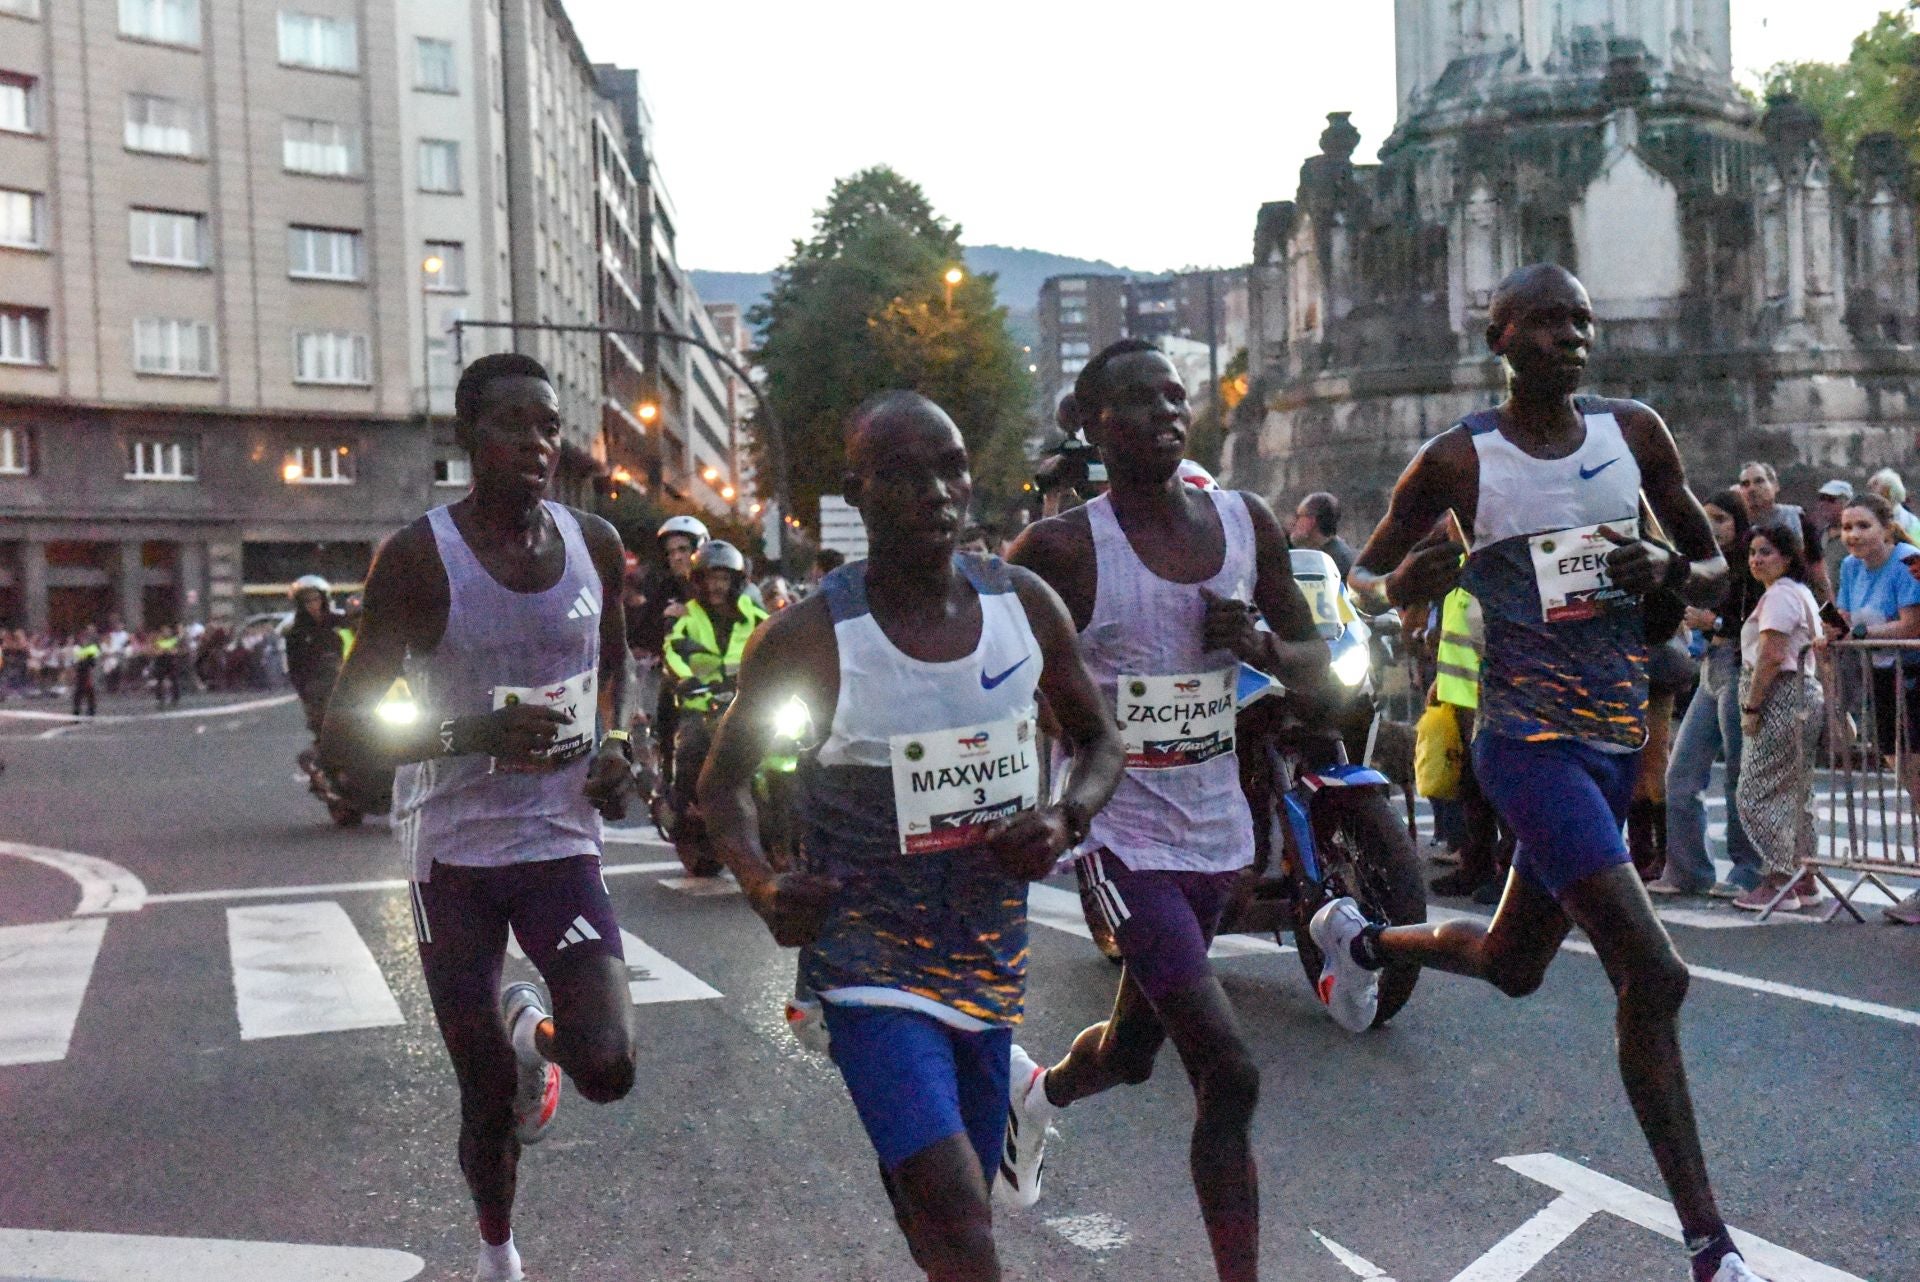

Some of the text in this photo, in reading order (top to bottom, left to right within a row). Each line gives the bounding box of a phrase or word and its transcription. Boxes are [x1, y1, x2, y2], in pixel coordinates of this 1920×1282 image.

[1127, 693, 1232, 723] ZACHARIA
[1180, 721, 1192, 735] 4
[911, 751, 1030, 793] MAXWELL
[973, 788, 986, 805] 3
